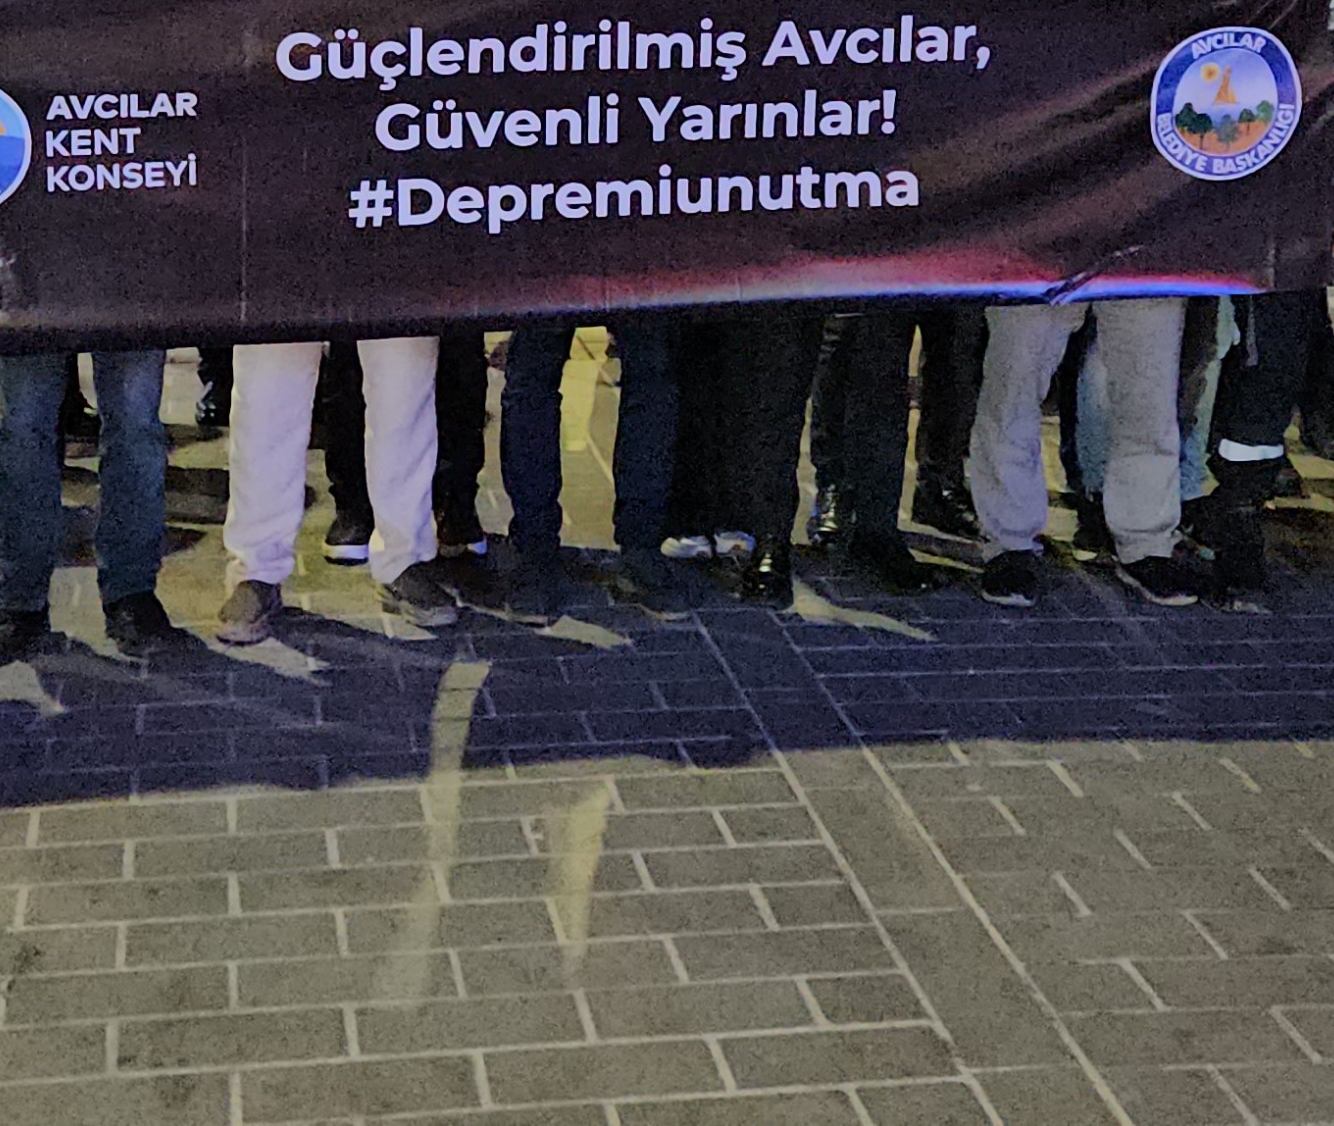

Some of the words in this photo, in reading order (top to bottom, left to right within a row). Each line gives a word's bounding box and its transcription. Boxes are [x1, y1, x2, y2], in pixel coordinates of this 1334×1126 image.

[275, 18, 747, 91] Güçlendirilmiş
[762, 15, 993, 70] Avcılar,
[1190, 31, 1267, 61] AVCILAR
[45, 92, 199, 121] AVCILAR
[374, 93, 620, 152] Güvenli
[638, 89, 898, 144] Yarınlar!
[45, 127, 142, 158] KENT
[46, 152, 198, 193] KONSEYİ
[348, 164, 921, 235] #Depremiunutma
